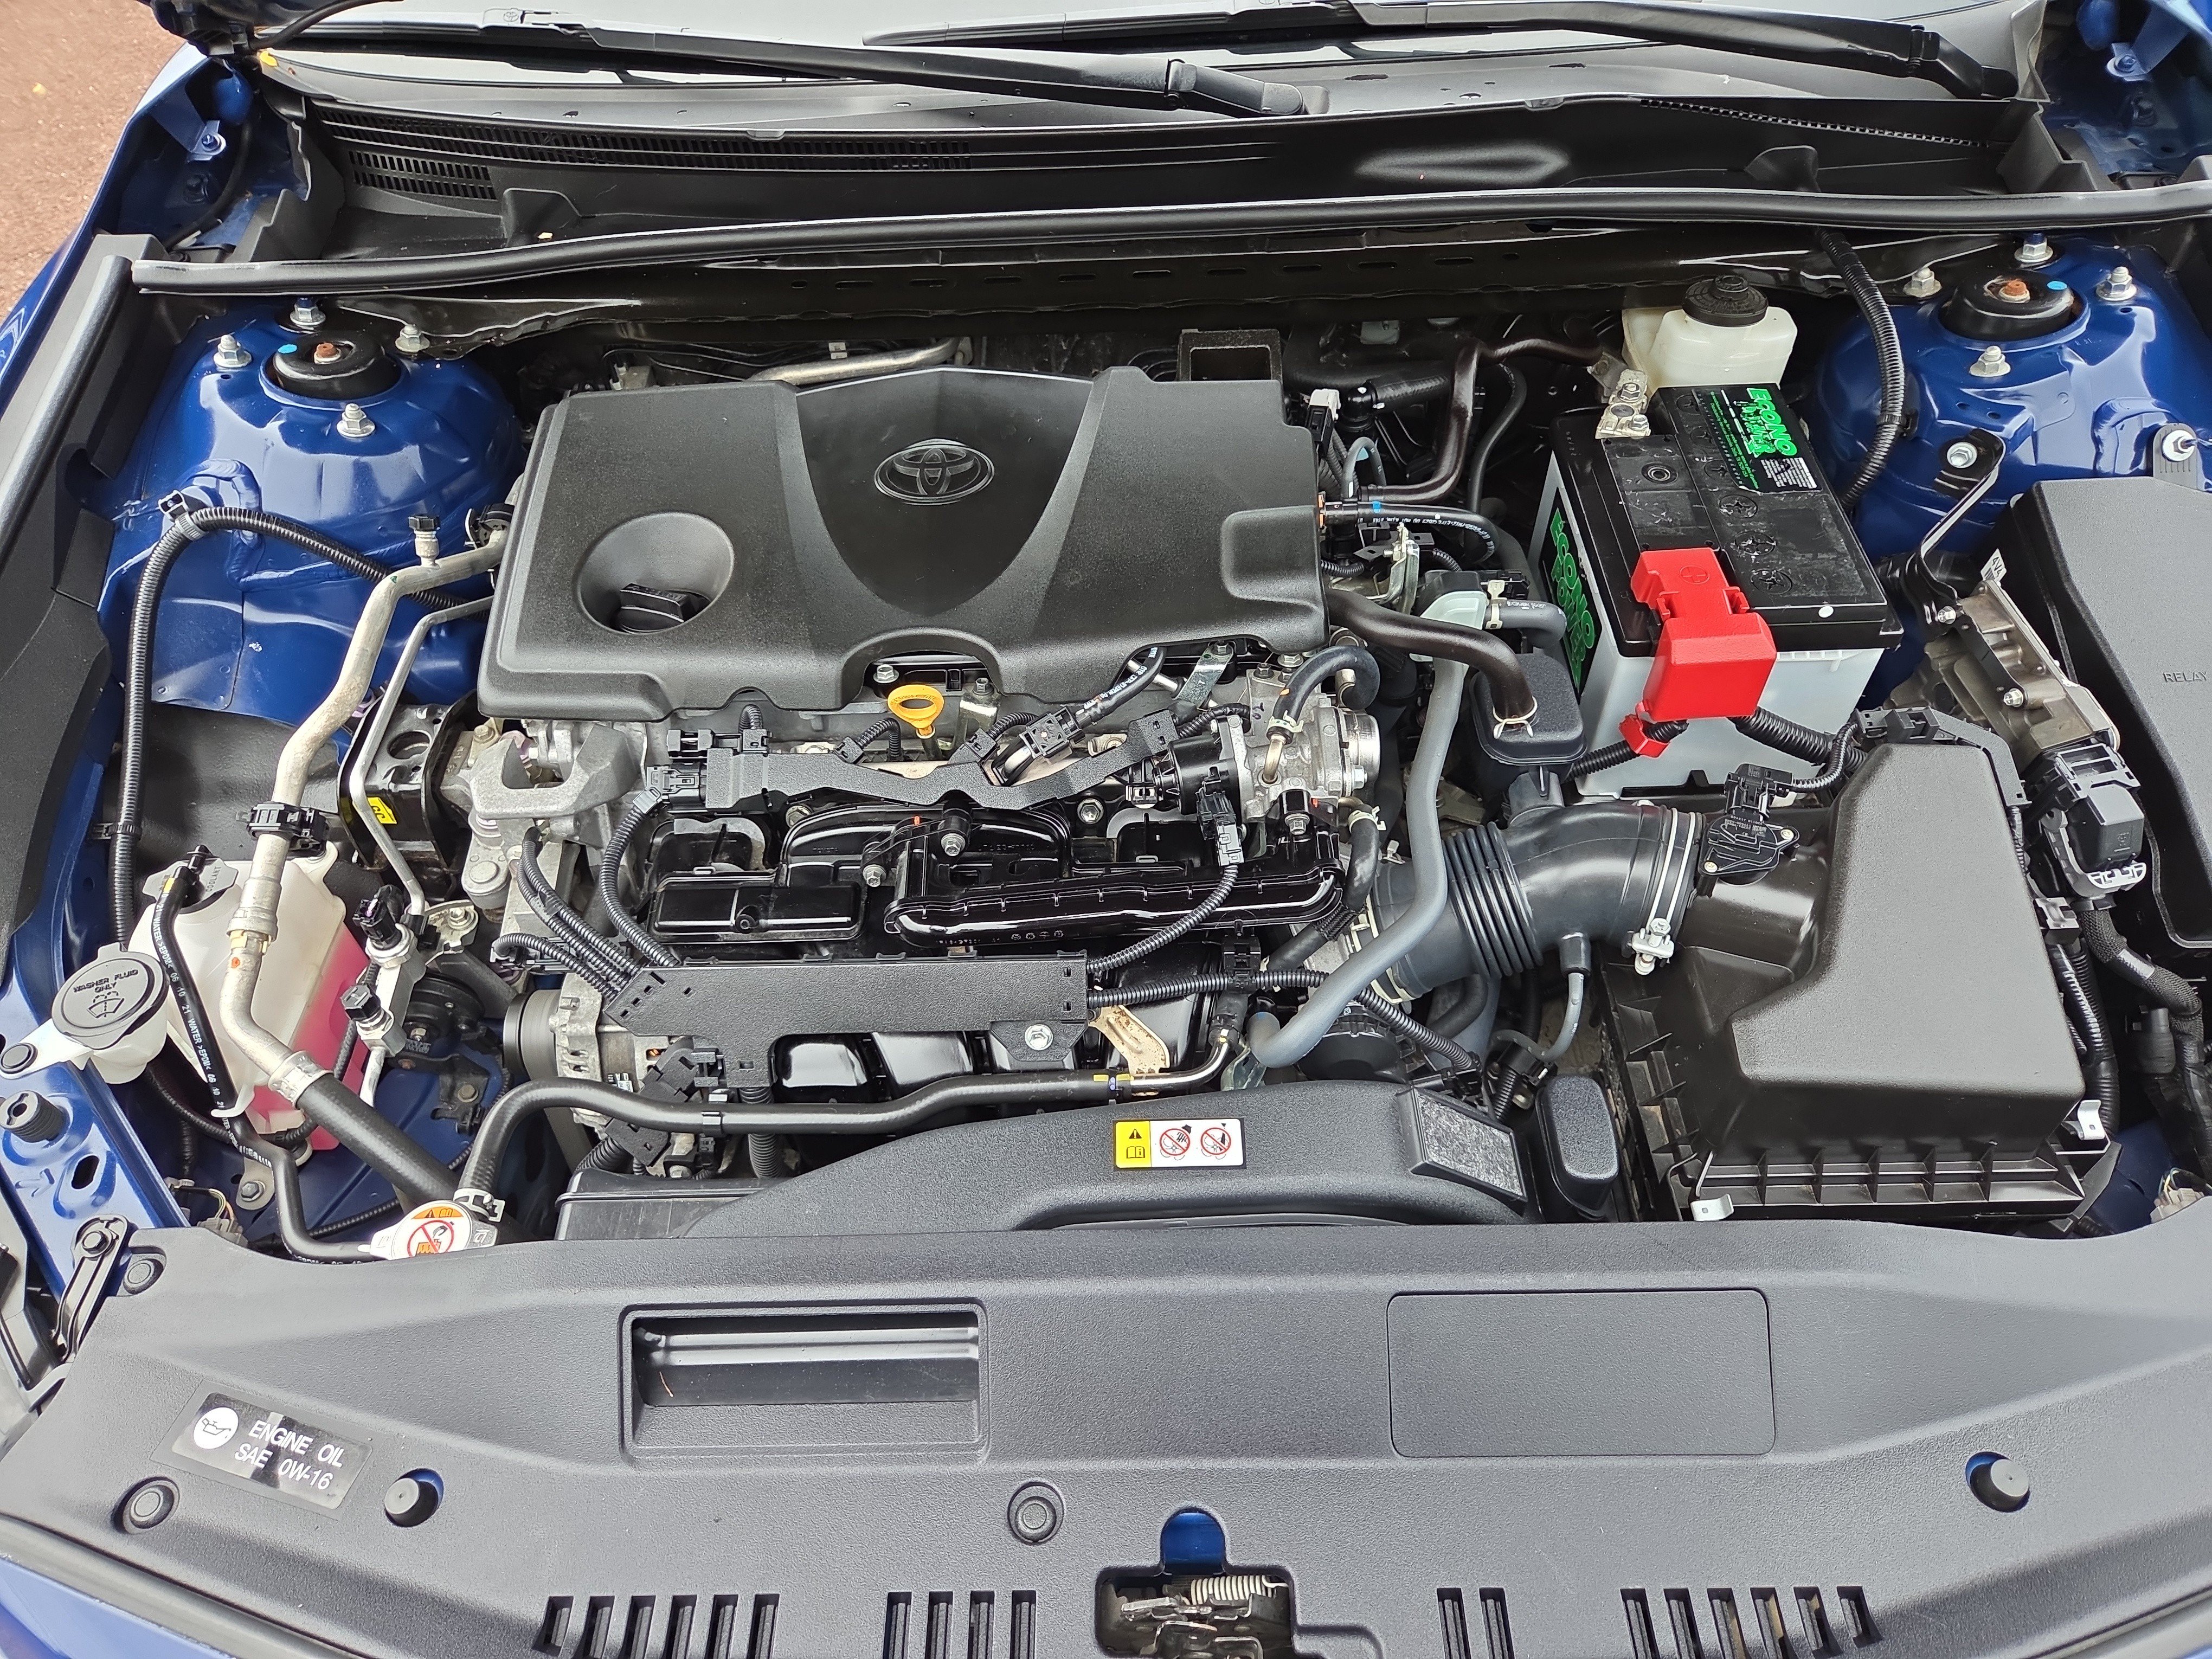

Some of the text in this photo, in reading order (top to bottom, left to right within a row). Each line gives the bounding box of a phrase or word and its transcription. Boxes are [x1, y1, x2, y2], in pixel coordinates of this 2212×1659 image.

[1747, 387, 1797, 456] ECONO
[1550, 507, 1595, 649] ECONO
[2163, 671, 2207, 683] RELAY
[205, 866, 221, 893] COOLANT
[73, 969, 139, 993] WASHER FLUID
[94, 981, 117, 993] ONLY
[153, 917, 163, 942] WATER
[170, 972, 179, 982] 06
[177, 987, 186, 997] 10
[182, 1005, 191, 1014] 21
[188, 1018, 202, 1044] WATER
[207, 1073, 216, 1083] 06
[235, 1443, 333, 1490] SAE 0W-16
[248, 1419, 344, 1468] ENGINE OIL
